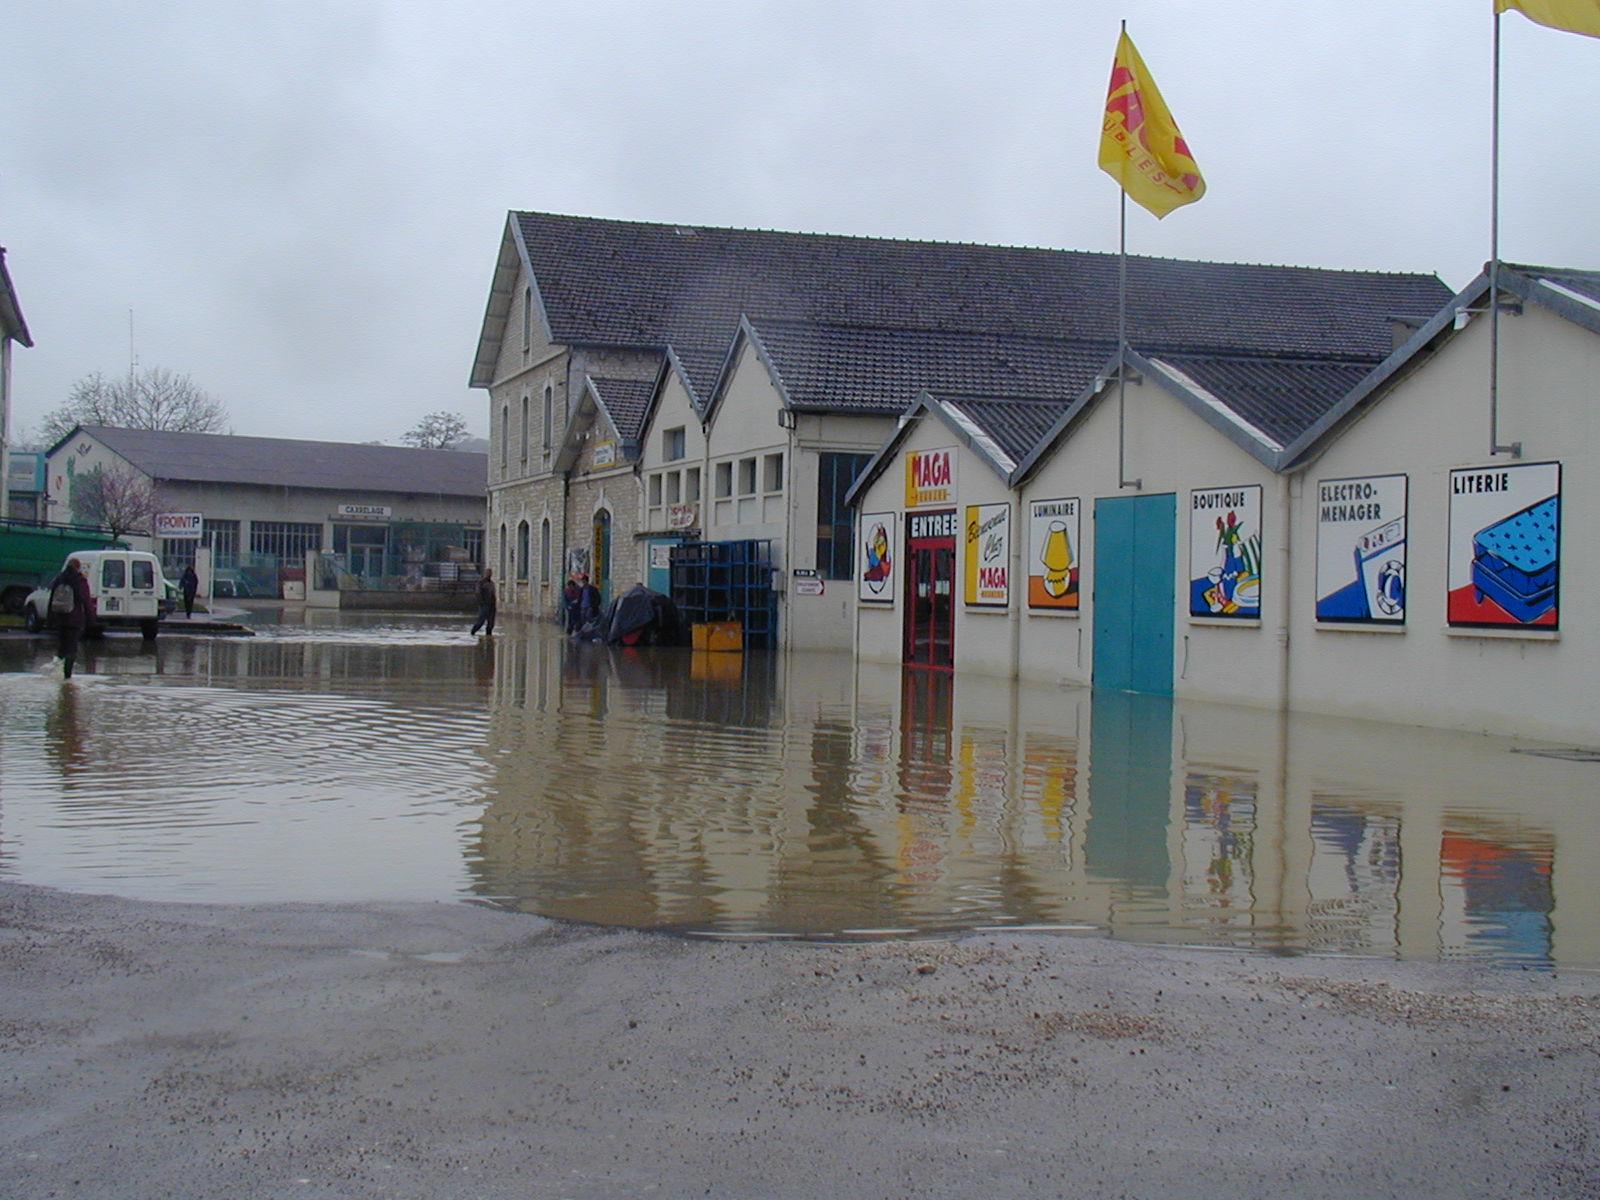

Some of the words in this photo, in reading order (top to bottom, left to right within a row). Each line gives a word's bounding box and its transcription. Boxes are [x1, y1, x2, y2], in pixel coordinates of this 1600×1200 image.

[911, 452, 950, 488] MAGA
[1454, 473, 1508, 494] LITERIE
[1034, 502, 1074, 518] LUMINAIRE
[1194, 492, 1245, 510] BOUTIQUE
[1321, 503, 1381, 522] MENAGER
[911, 514, 957, 538] ENTREE
[979, 567, 1007, 588] MAGA
